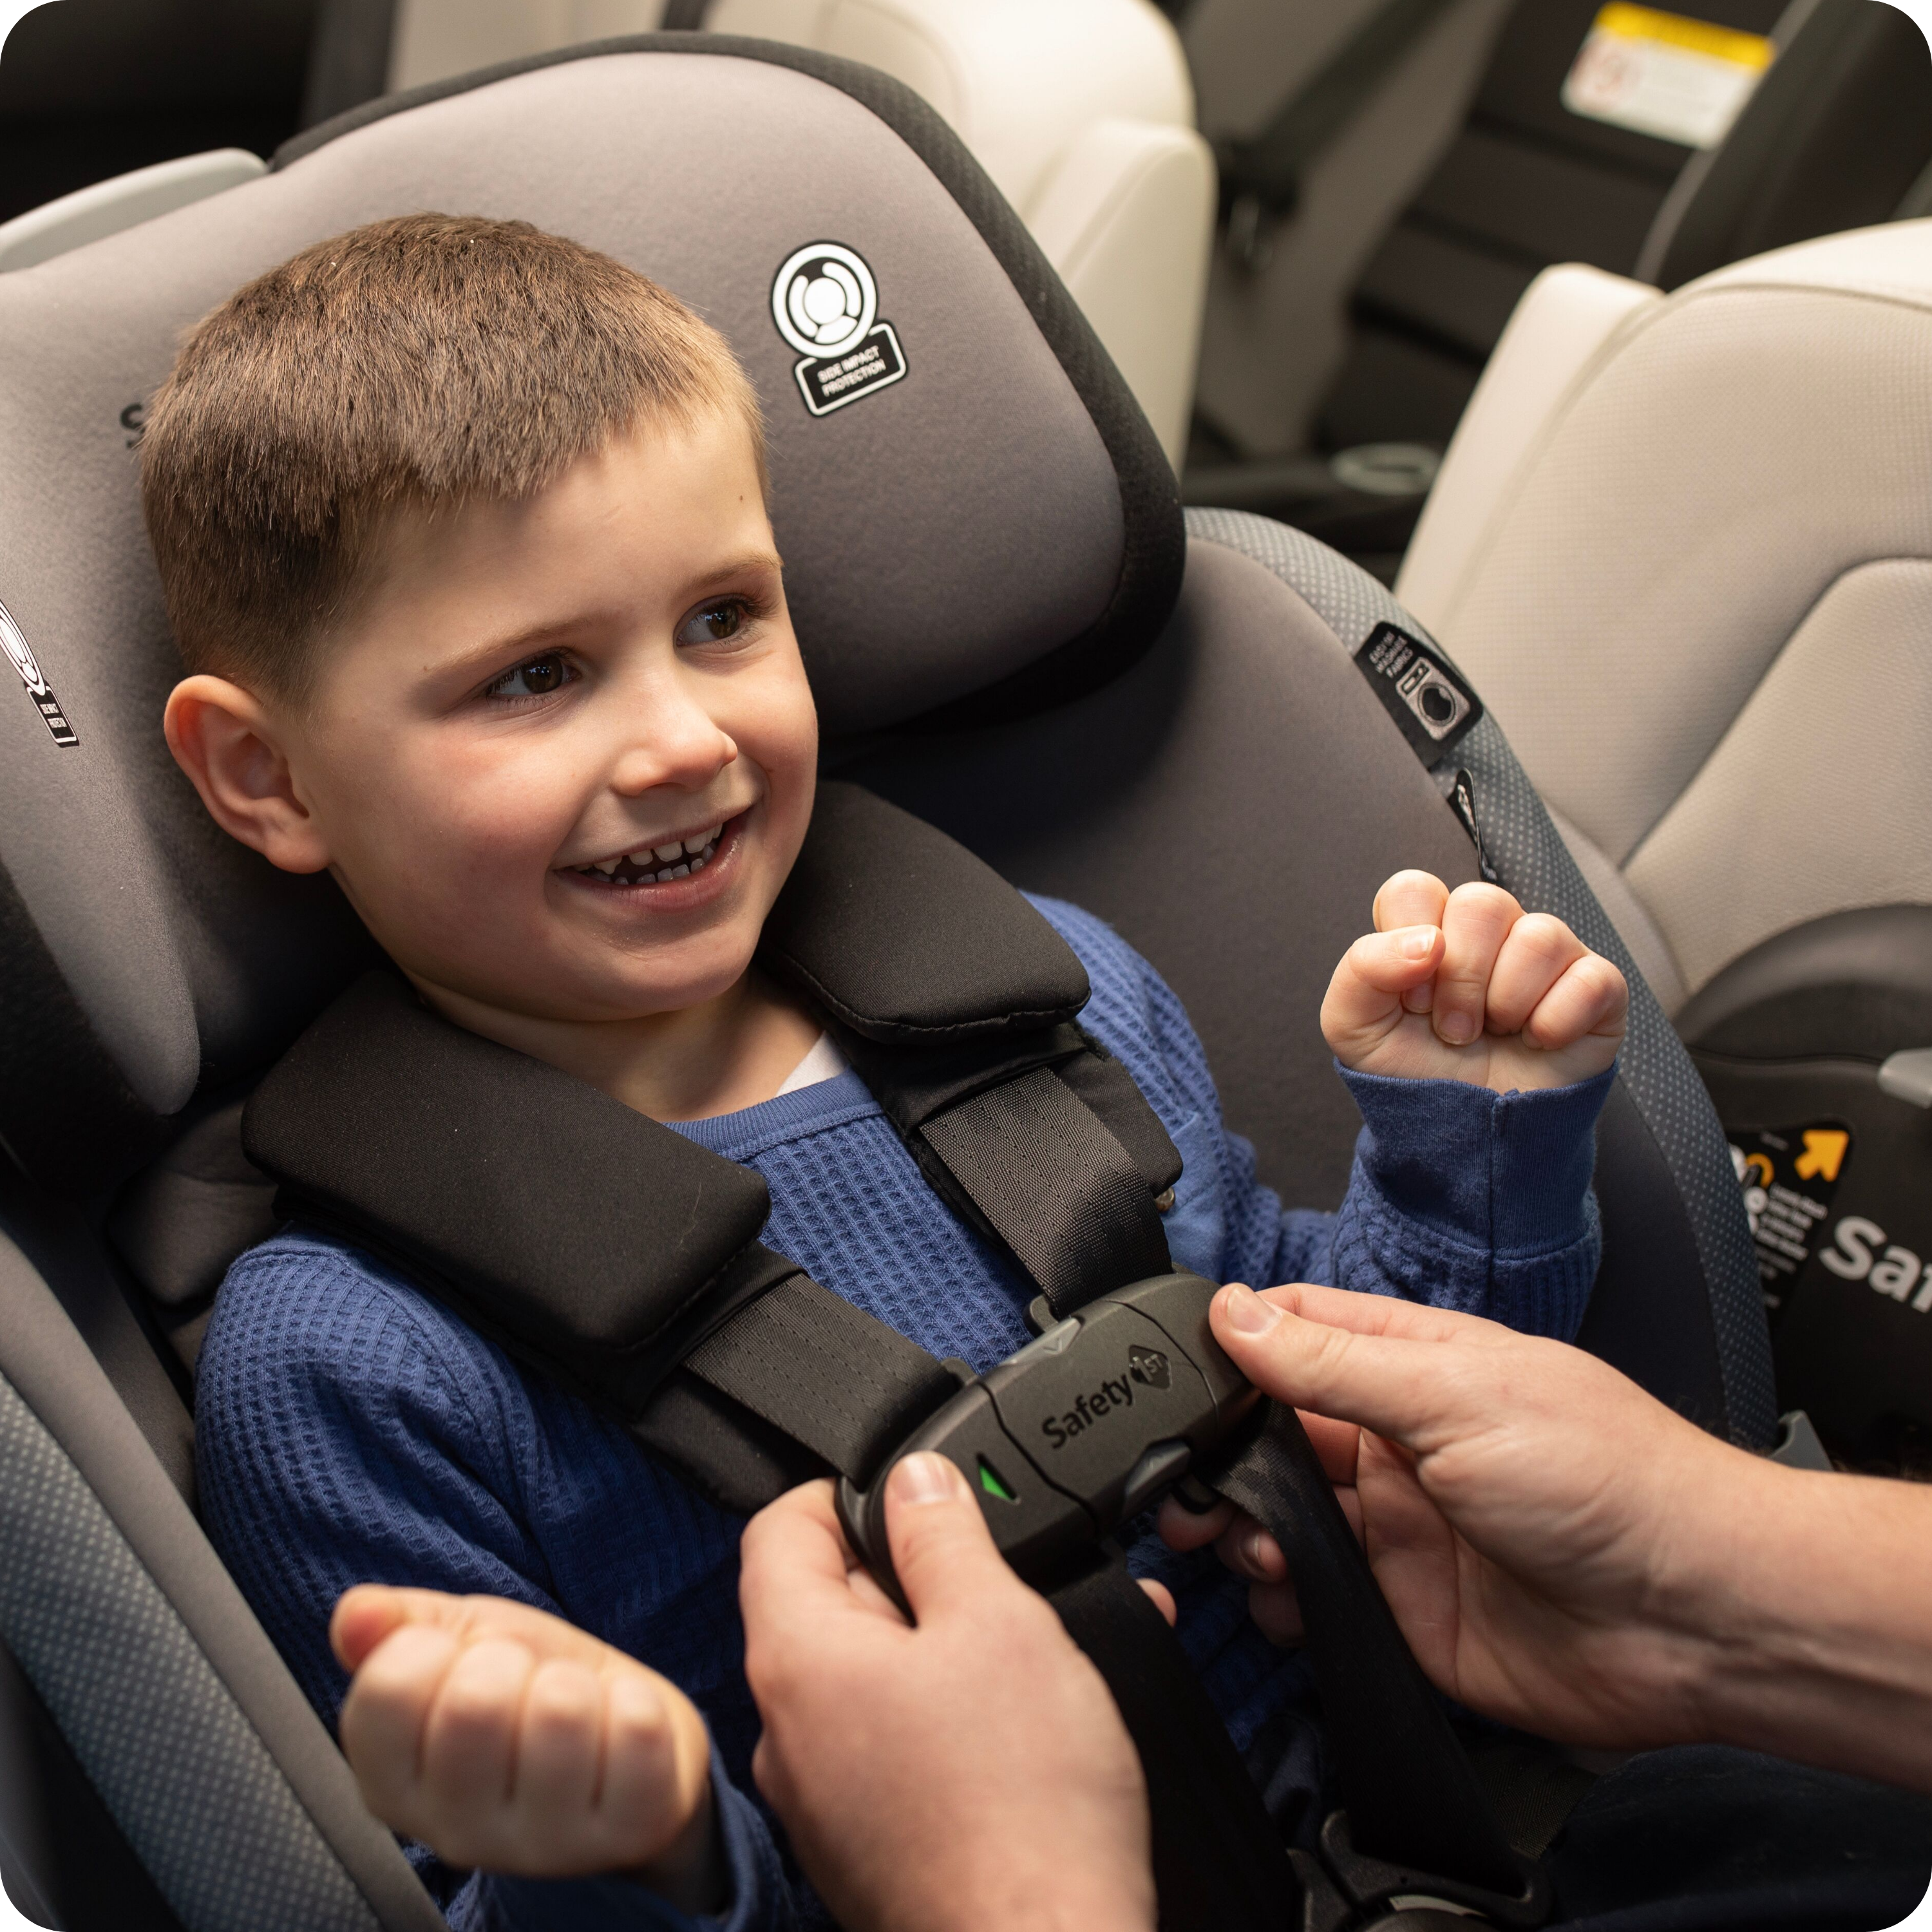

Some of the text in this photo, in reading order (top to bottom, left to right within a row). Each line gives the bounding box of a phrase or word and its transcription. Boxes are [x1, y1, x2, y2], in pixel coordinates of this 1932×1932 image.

[817, 345, 879, 383] SIDE IMPACT
[822, 358, 886, 397] PROTECTION
[1042, 1374, 1133, 1449] Safety
